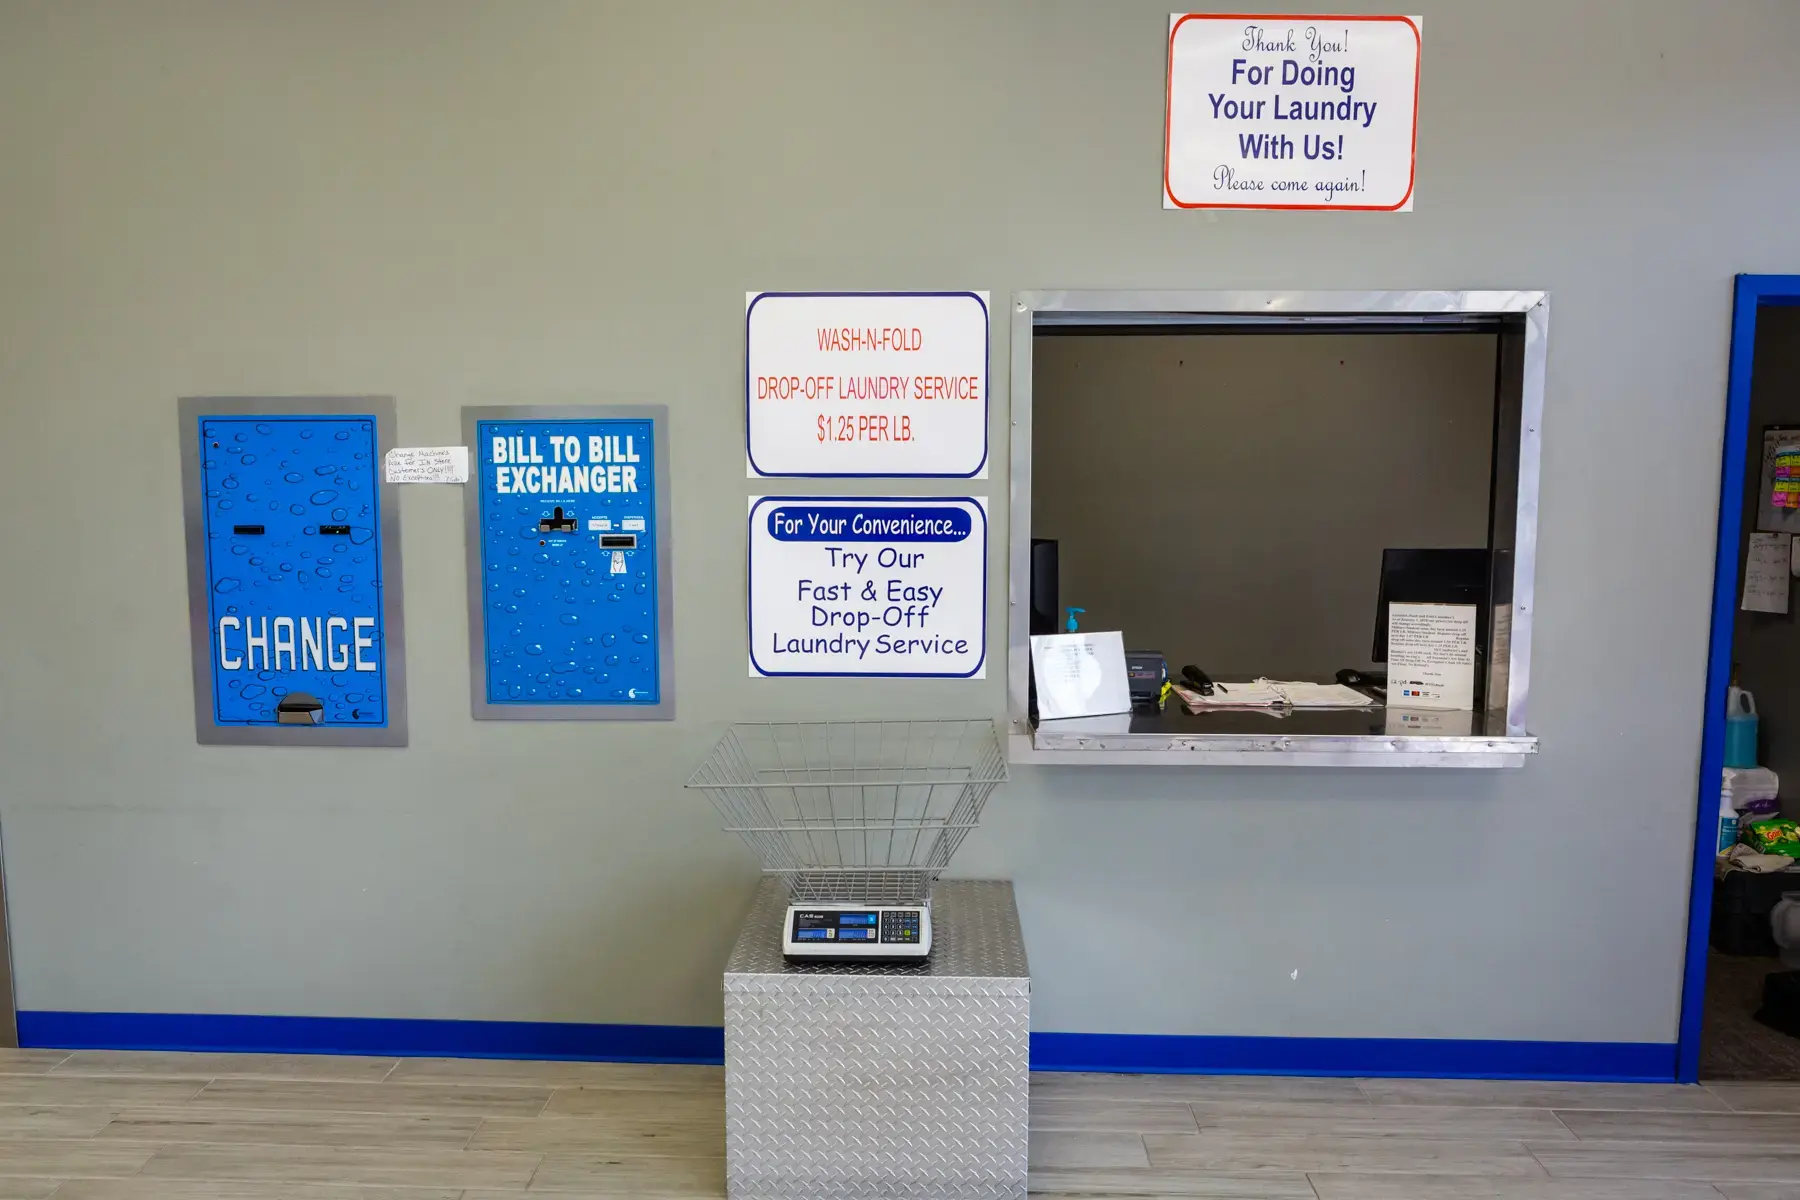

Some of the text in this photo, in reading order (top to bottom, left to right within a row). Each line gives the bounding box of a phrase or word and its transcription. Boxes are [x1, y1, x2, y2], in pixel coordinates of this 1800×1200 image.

[1242, 26, 1348, 62] Thank You!
[1232, 59, 1355, 93] For Doing
[1208, 94, 1377, 128] Your Laundry
[1239, 134, 1343, 160] With Us!
[1213, 165, 1365, 201] Please come again!
[817, 328, 921, 351] WASH-N-FOLD
[758, 377, 978, 399] DROP-OFF LAUNDRY SERVICE
[818, 413, 914, 444] $1.25 PER LB.
[389, 450, 414, 460] Change
[493, 436, 640, 463] BILL TO BILL
[497, 466, 638, 493] EXCHANGER
[774, 512, 966, 535] For Your Convenience...
[825, 548, 924, 574] Try Our
[798, 580, 943, 607] Fast & Easy
[812, 605, 930, 632] Drop-Off
[219, 616, 376, 671] CHANGE
[773, 633, 968, 659] Laundry Service
[1767, 830, 1782, 840] Gain
